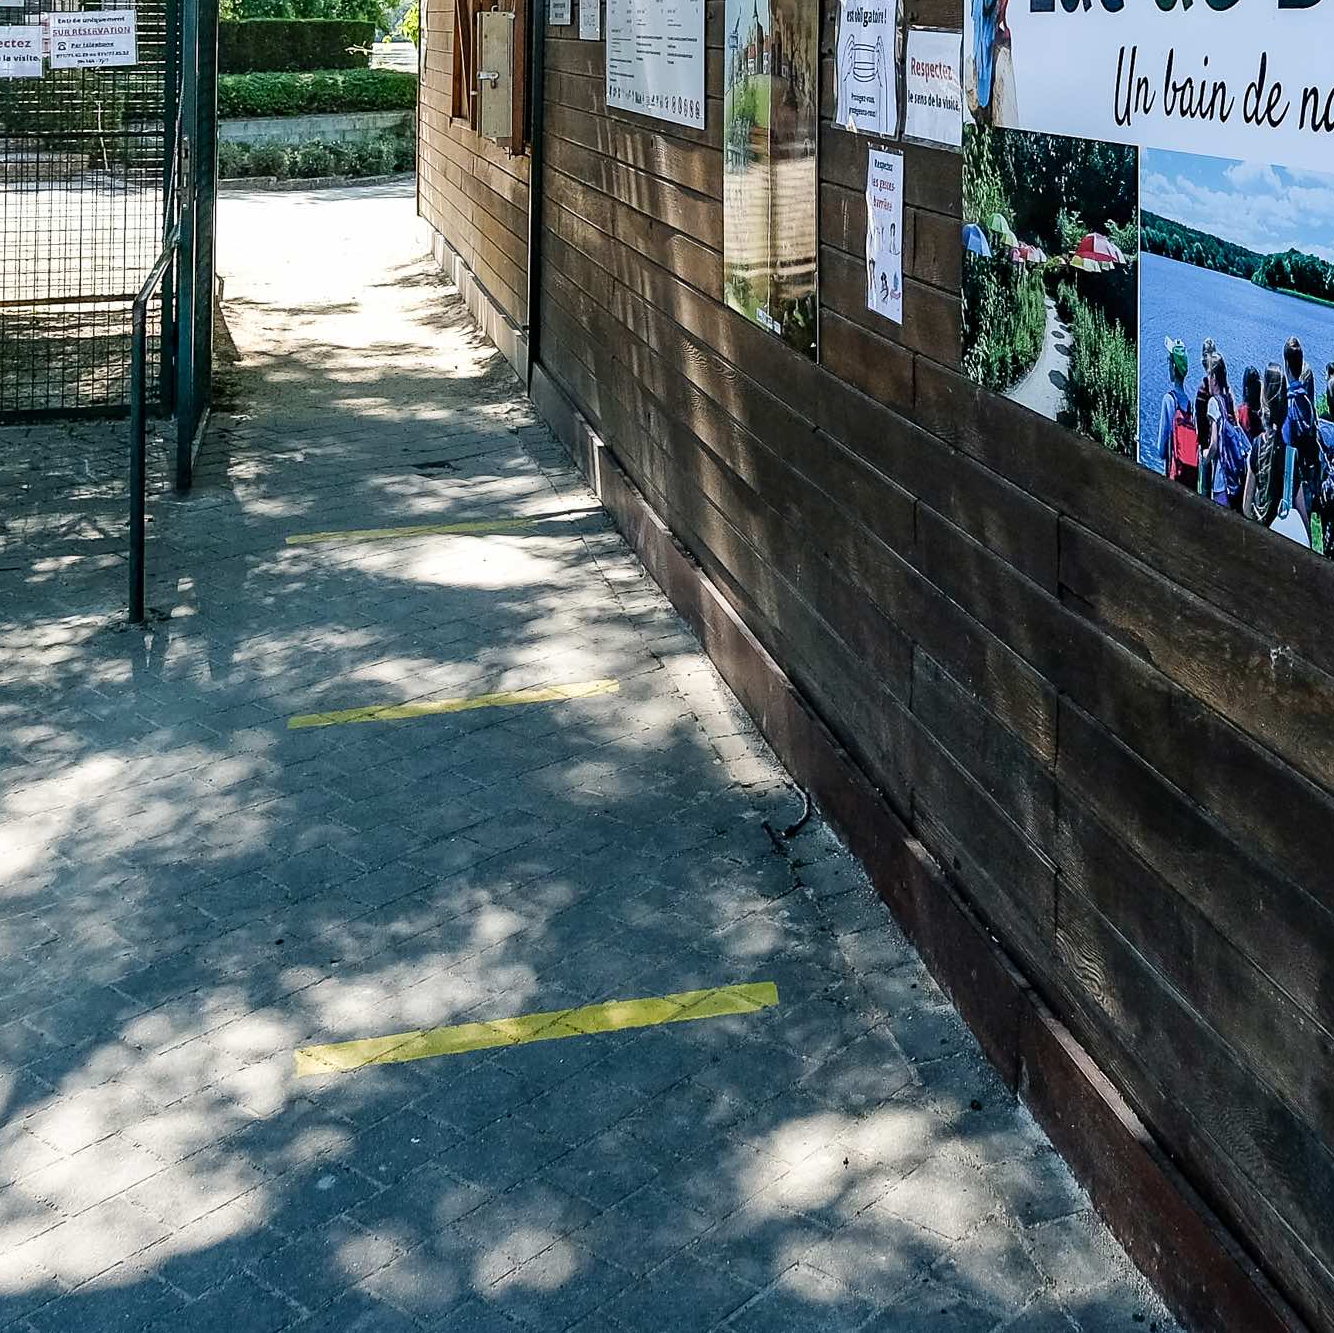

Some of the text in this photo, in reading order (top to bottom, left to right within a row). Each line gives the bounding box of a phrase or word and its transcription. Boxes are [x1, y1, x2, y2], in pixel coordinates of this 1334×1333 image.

[846, 10, 854, 23] est
[52, 26, 131, 37] SUR RÉSERVATION
[3, 54, 12, 62] la
[911, 56, 953, 82] Respectez
[1113, 46, 1156, 126] Un
[1164, 47, 1235, 123] bain
[1243, 51, 1290, 129] de
[908, 90, 914, 103] le
[914, 93, 927, 106] sens
[928, 93, 935, 107] de
[936, 94, 942, 107] la
